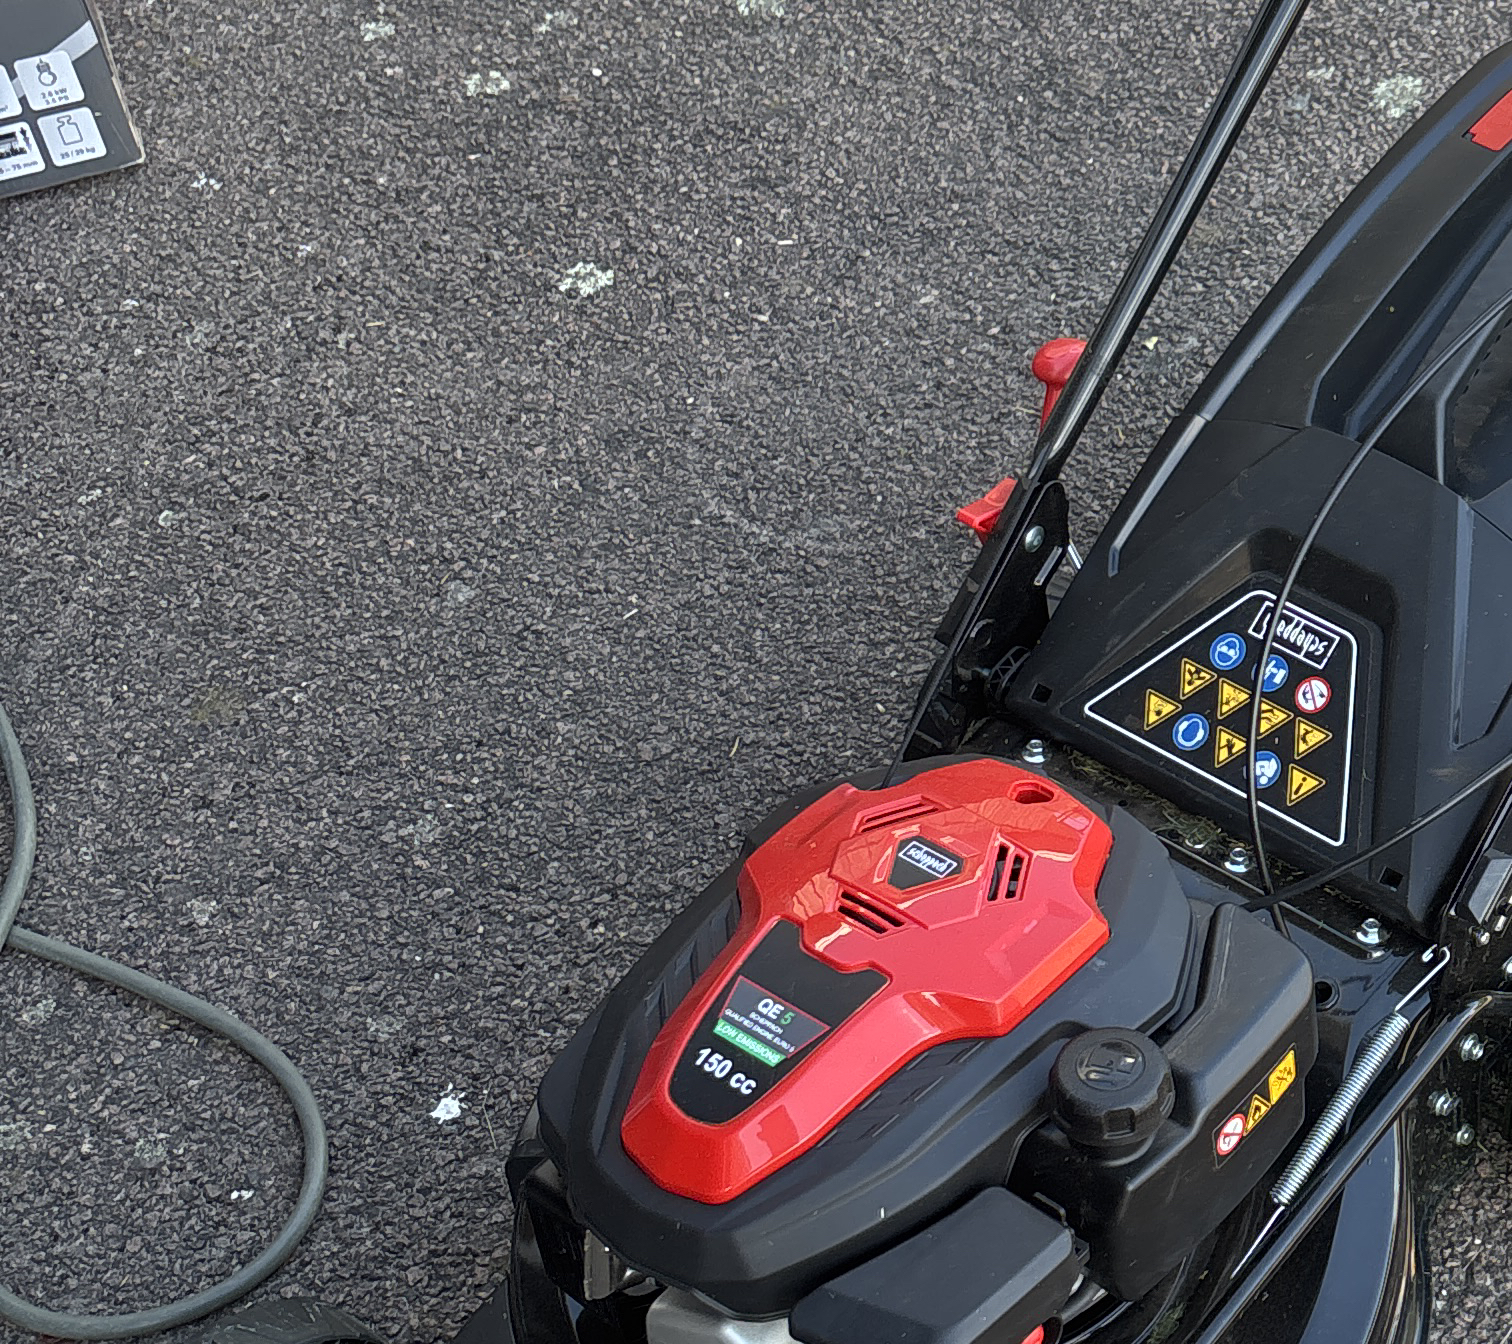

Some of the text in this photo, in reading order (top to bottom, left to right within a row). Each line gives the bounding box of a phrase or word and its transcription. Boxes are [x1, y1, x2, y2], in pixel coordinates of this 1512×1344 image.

[1260, 611, 1329, 657] scheppah
[758, 998, 796, 1025] QE 5
[716, 1021, 781, 1063] LOW EMISSIONS
[695, 1047, 757, 1095] 150 cc
